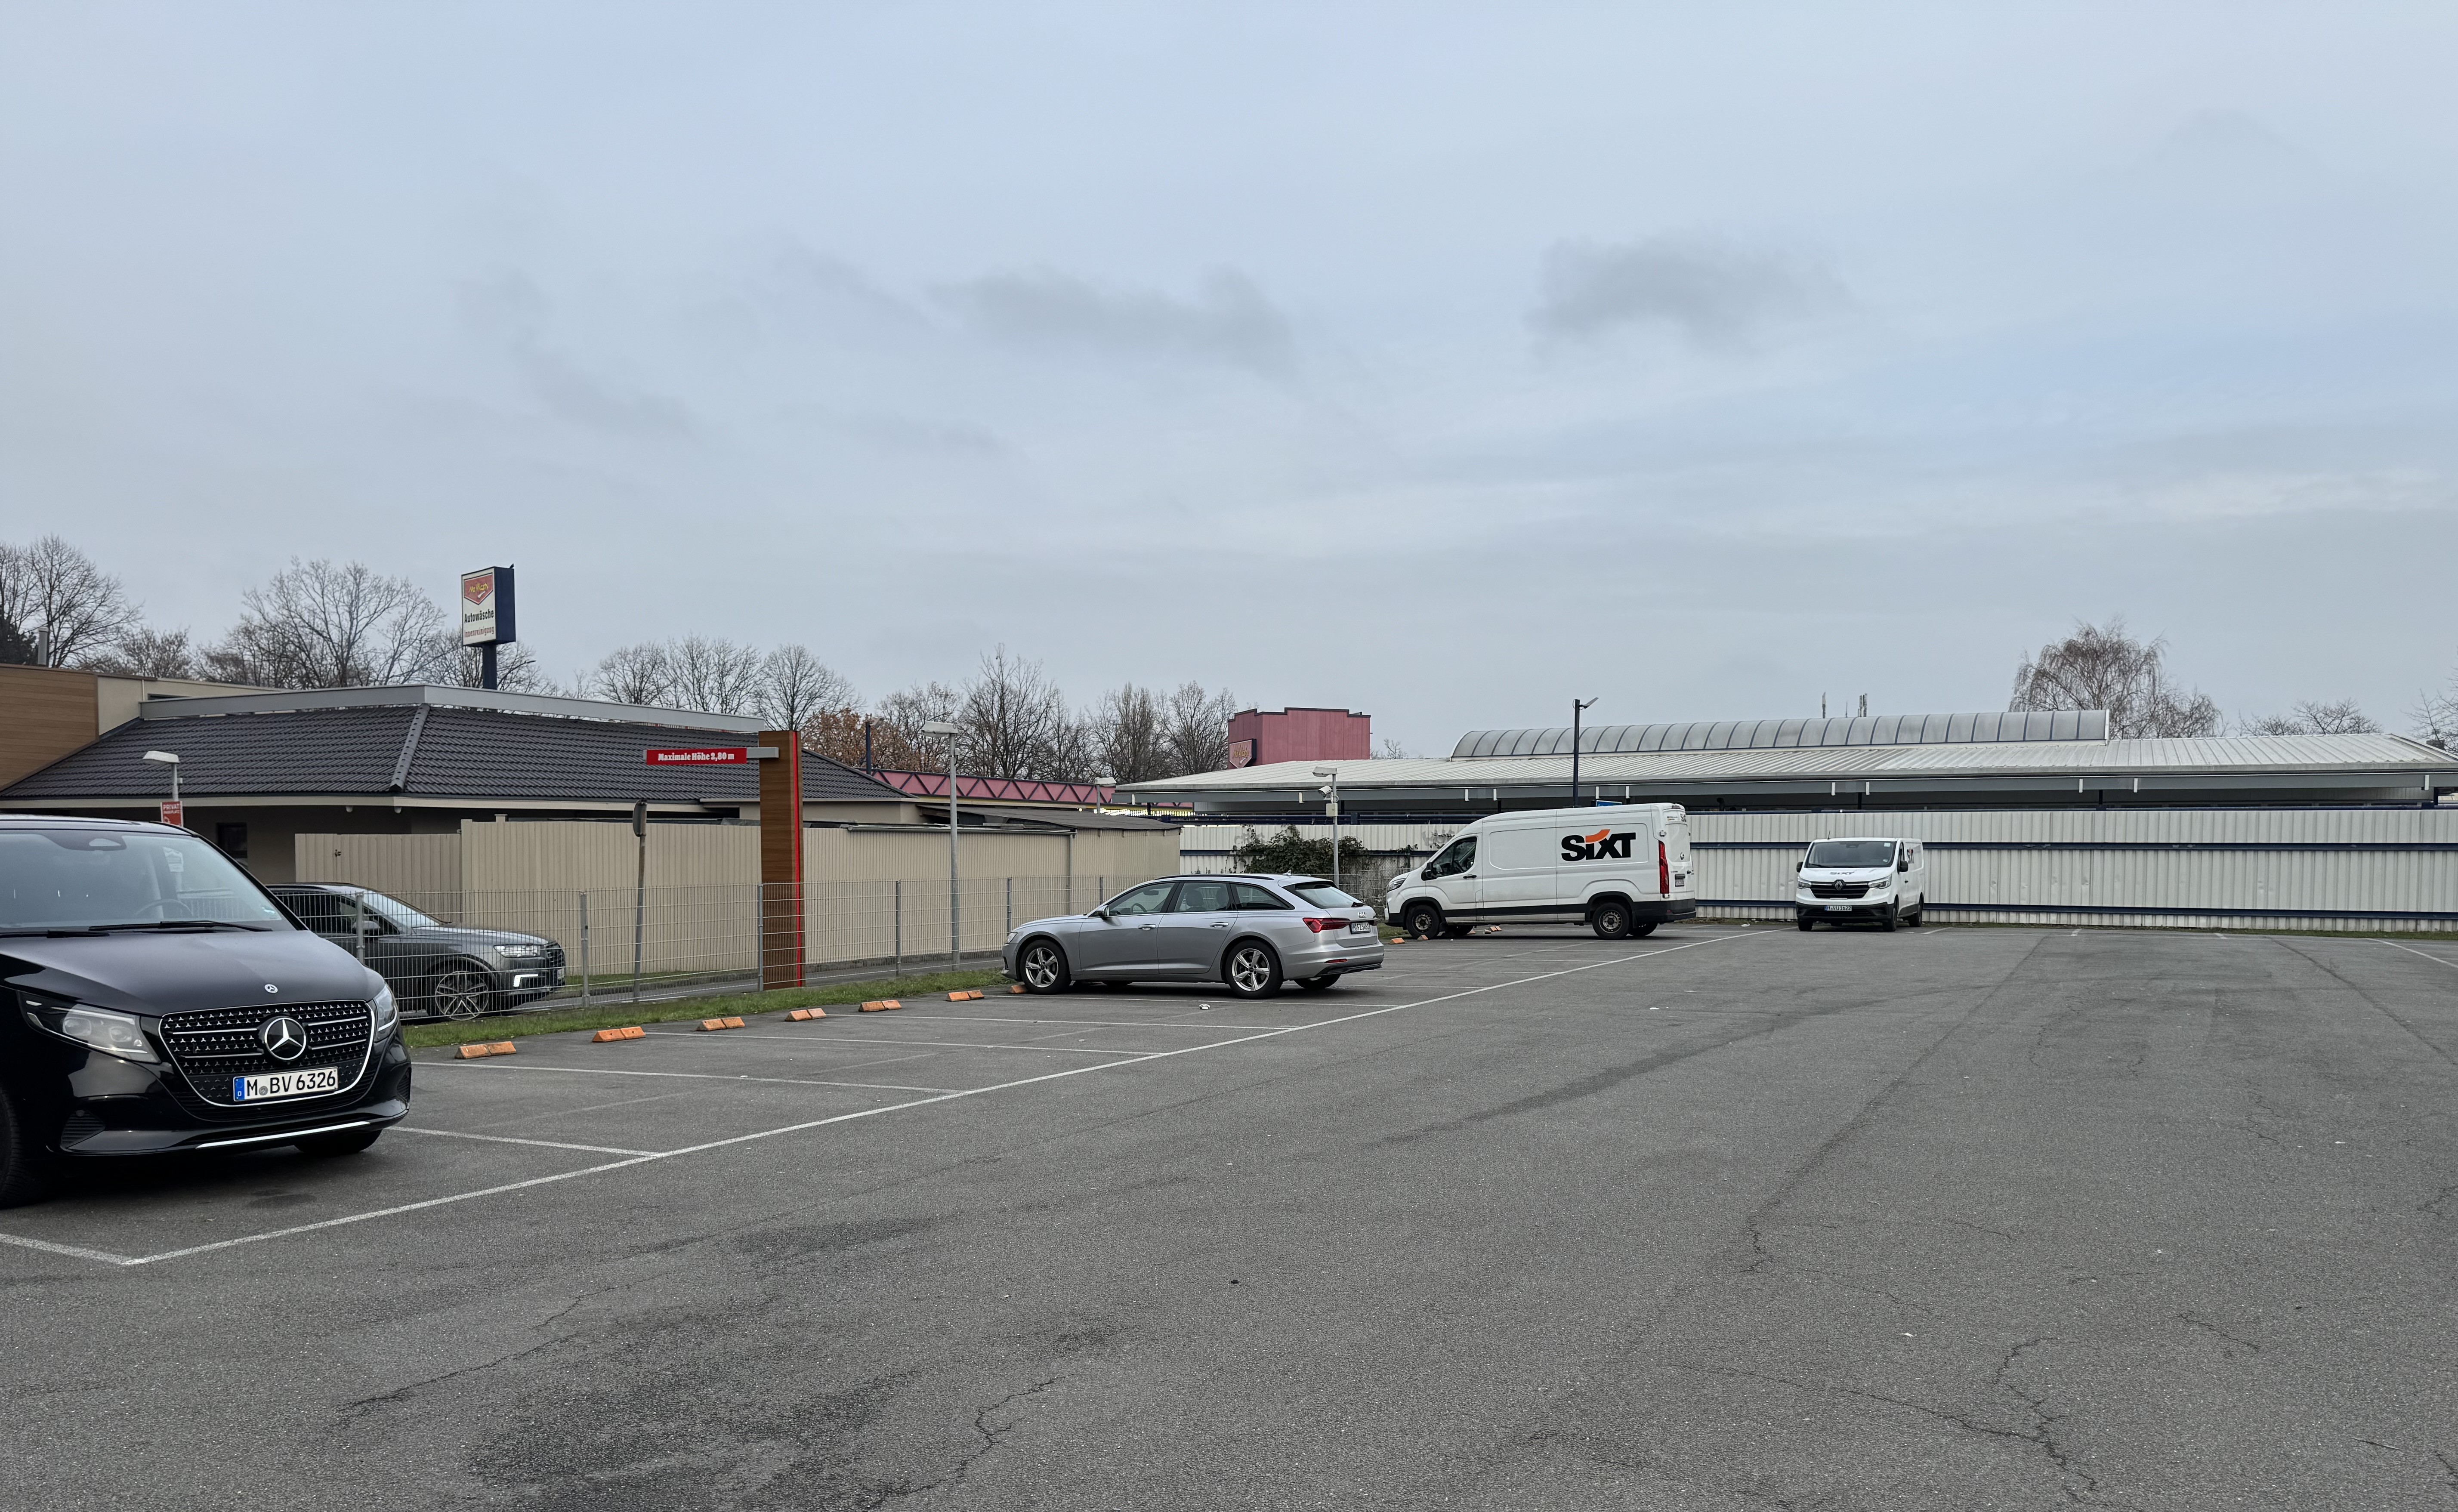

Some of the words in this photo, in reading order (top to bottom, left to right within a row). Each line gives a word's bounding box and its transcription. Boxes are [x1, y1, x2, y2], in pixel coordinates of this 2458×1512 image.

[464, 608, 494, 623] Autowäsche
[658, 753, 691, 761] Maximale
[692, 752, 710, 760] Höhe
[710, 752, 727, 761] 2,80
[1561, 829, 1636, 861] SIXT
[247, 1079, 258, 1096] M
[270, 1075, 292, 1094] BV
[296, 1071, 336, 1091] 6326
